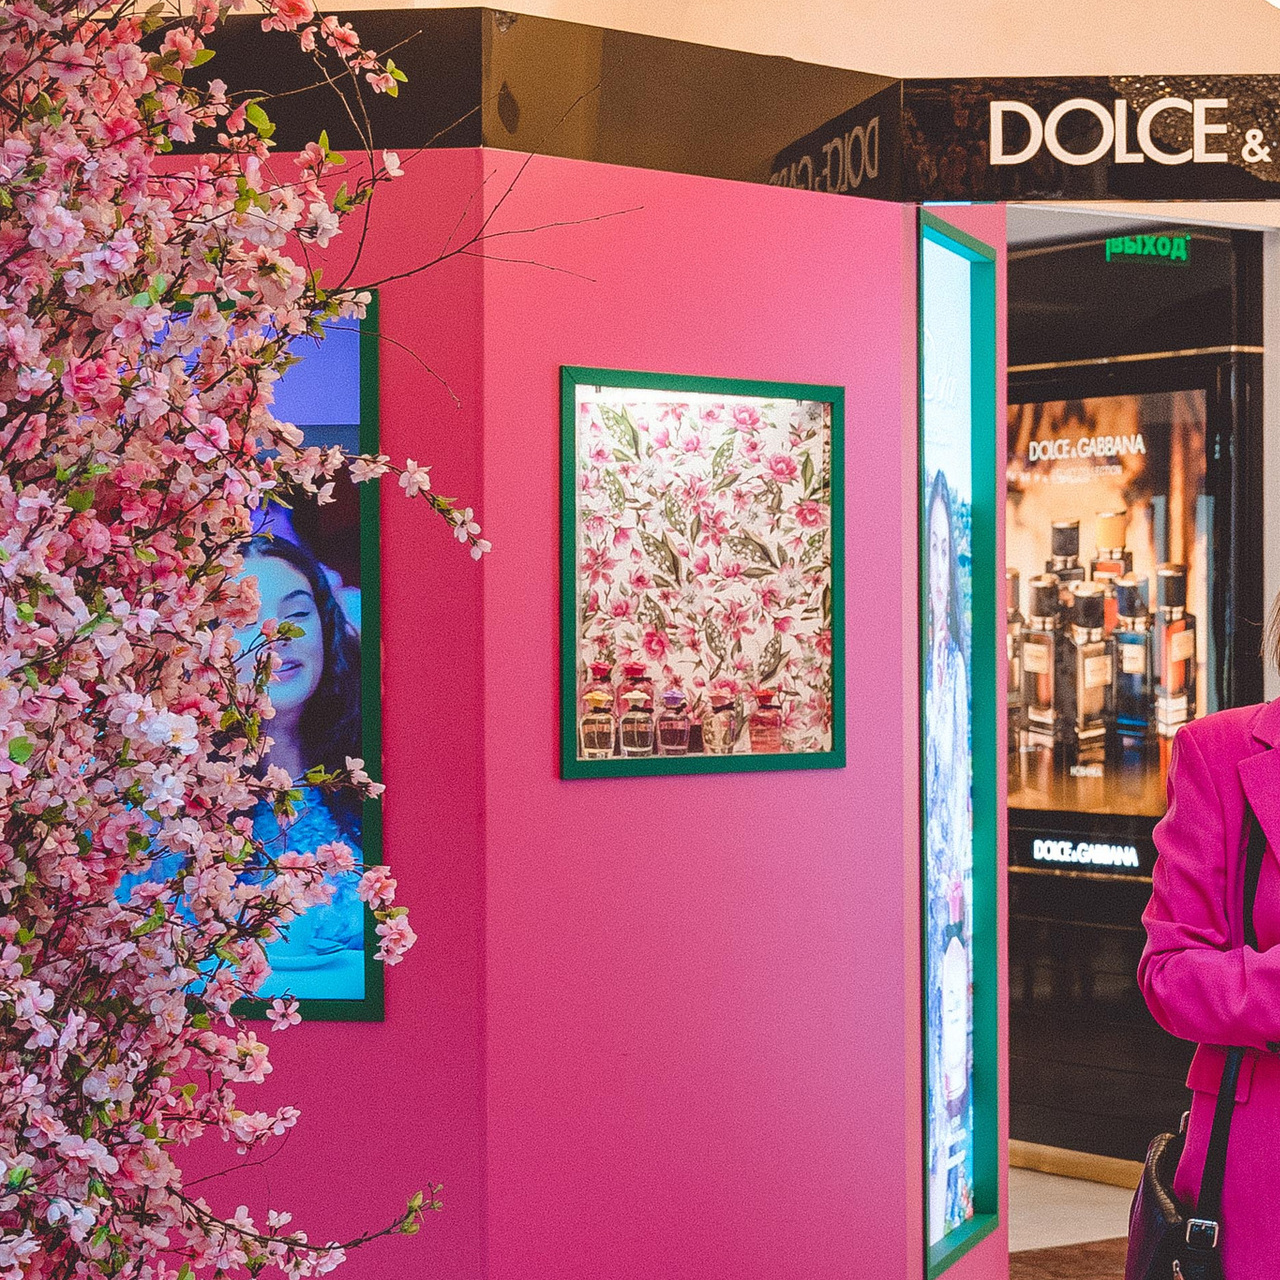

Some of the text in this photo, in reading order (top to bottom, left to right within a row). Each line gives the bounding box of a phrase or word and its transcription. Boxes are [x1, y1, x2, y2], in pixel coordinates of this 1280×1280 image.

[989, 96, 1228, 165] DOLCE
[1241, 128, 1272, 163] &
[1110, 235, 1187, 261] ВЫХОД
[1029, 438, 1070, 461] DOLCE
[1077, 433, 1146, 458] GABBANA
[1033, 839, 1072, 862] DOLCE
